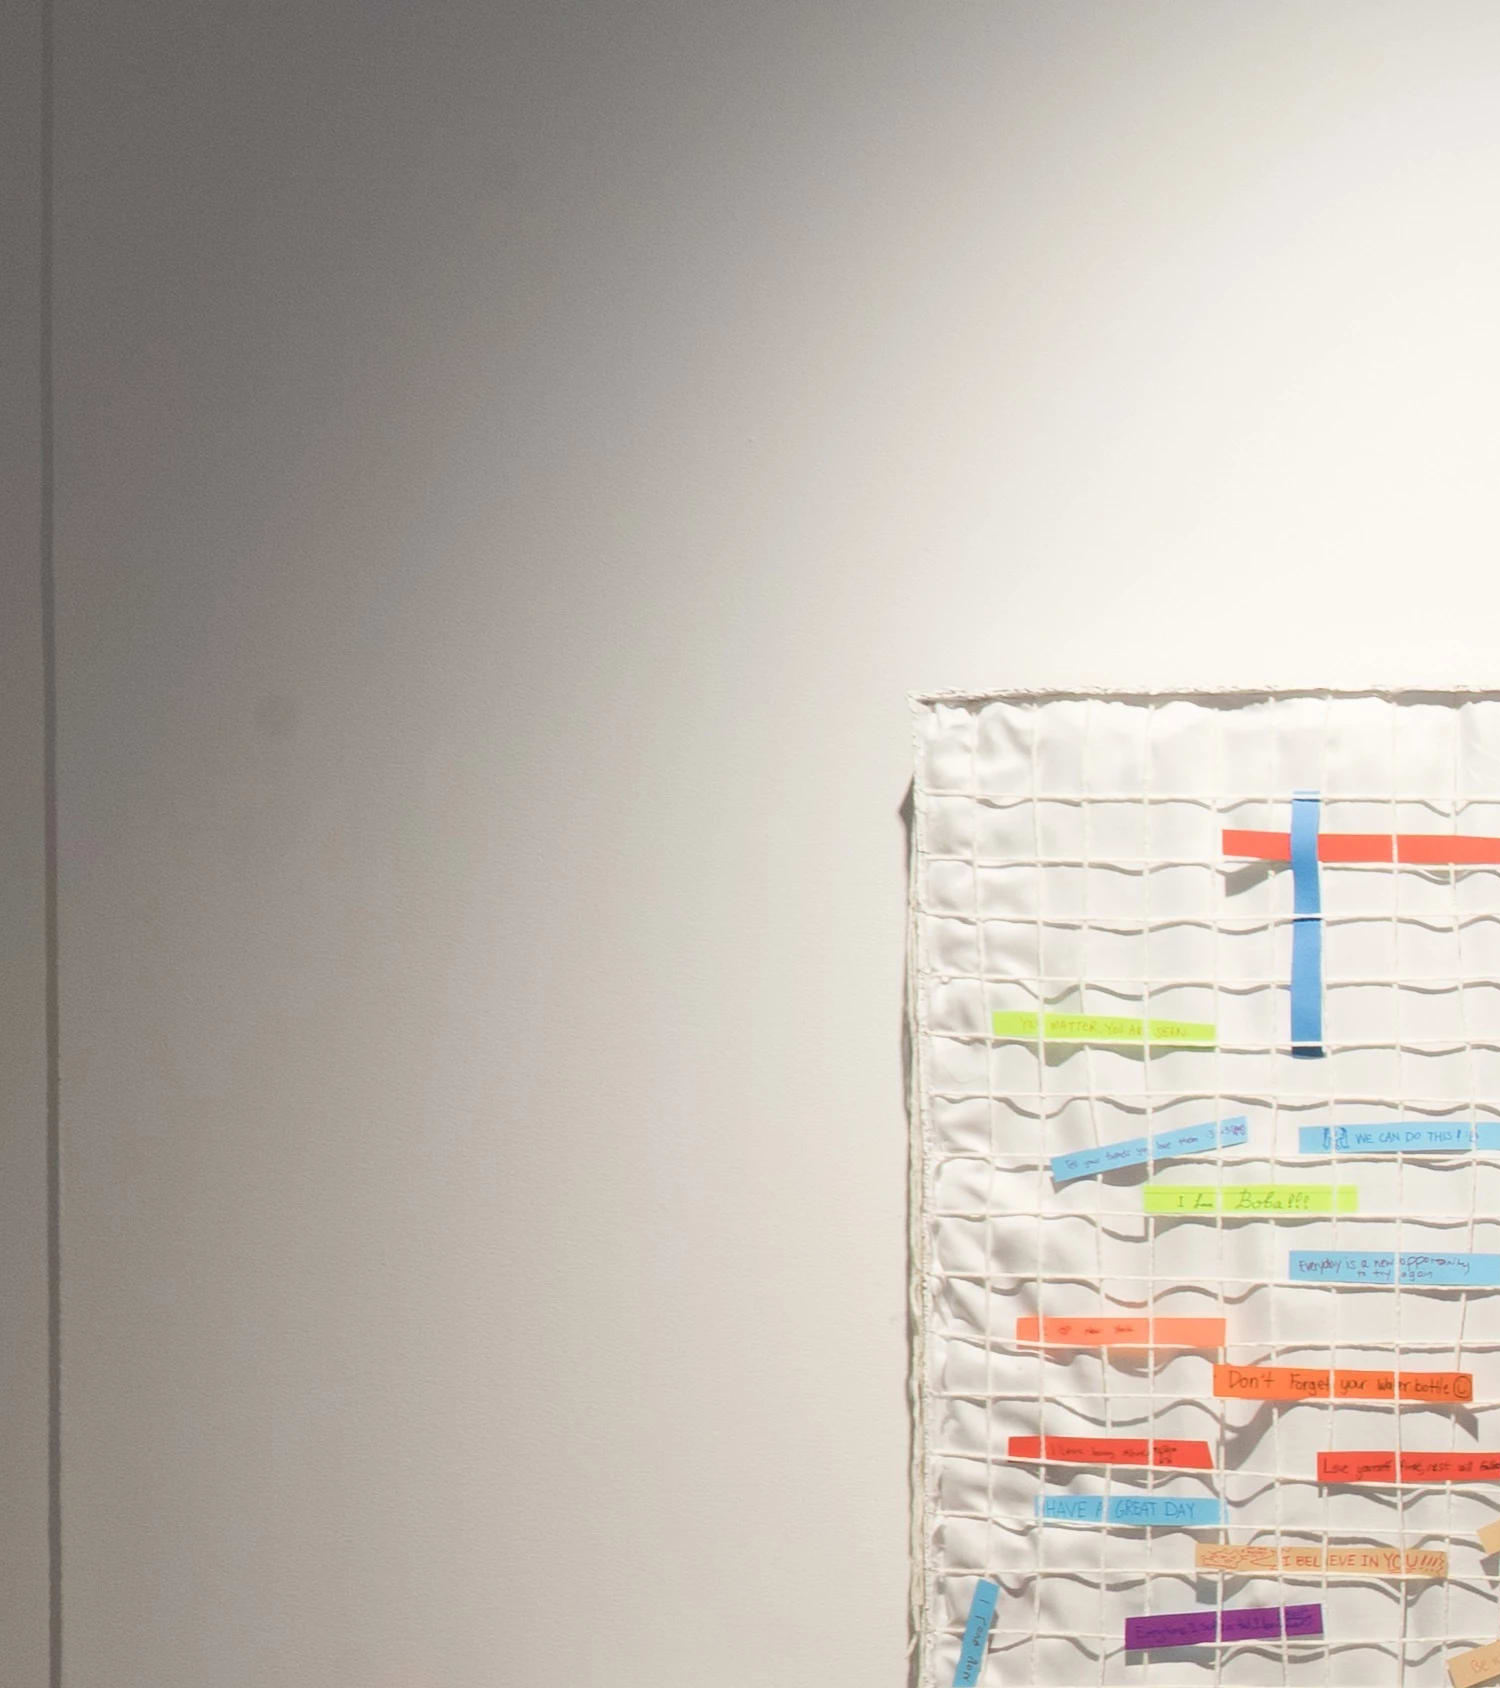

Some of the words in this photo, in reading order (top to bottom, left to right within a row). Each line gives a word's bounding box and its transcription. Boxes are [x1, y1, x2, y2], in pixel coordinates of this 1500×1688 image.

[1354, 1130, 1374, 1145] WE
[1378, 1130, 1400, 1143] CAN
[1405, 1131, 1422, 1143] DO
[1227, 1370, 1276, 1390] Don't
[1045, 1500, 1088, 1518] HAVE
[1113, 1499, 1158, 1519] GREAT
[1165, 1500, 1196, 1519] DAY
[1296, 1554, 1360, 1568] BELEVE
[1361, 1555, 1380, 1568] IN
